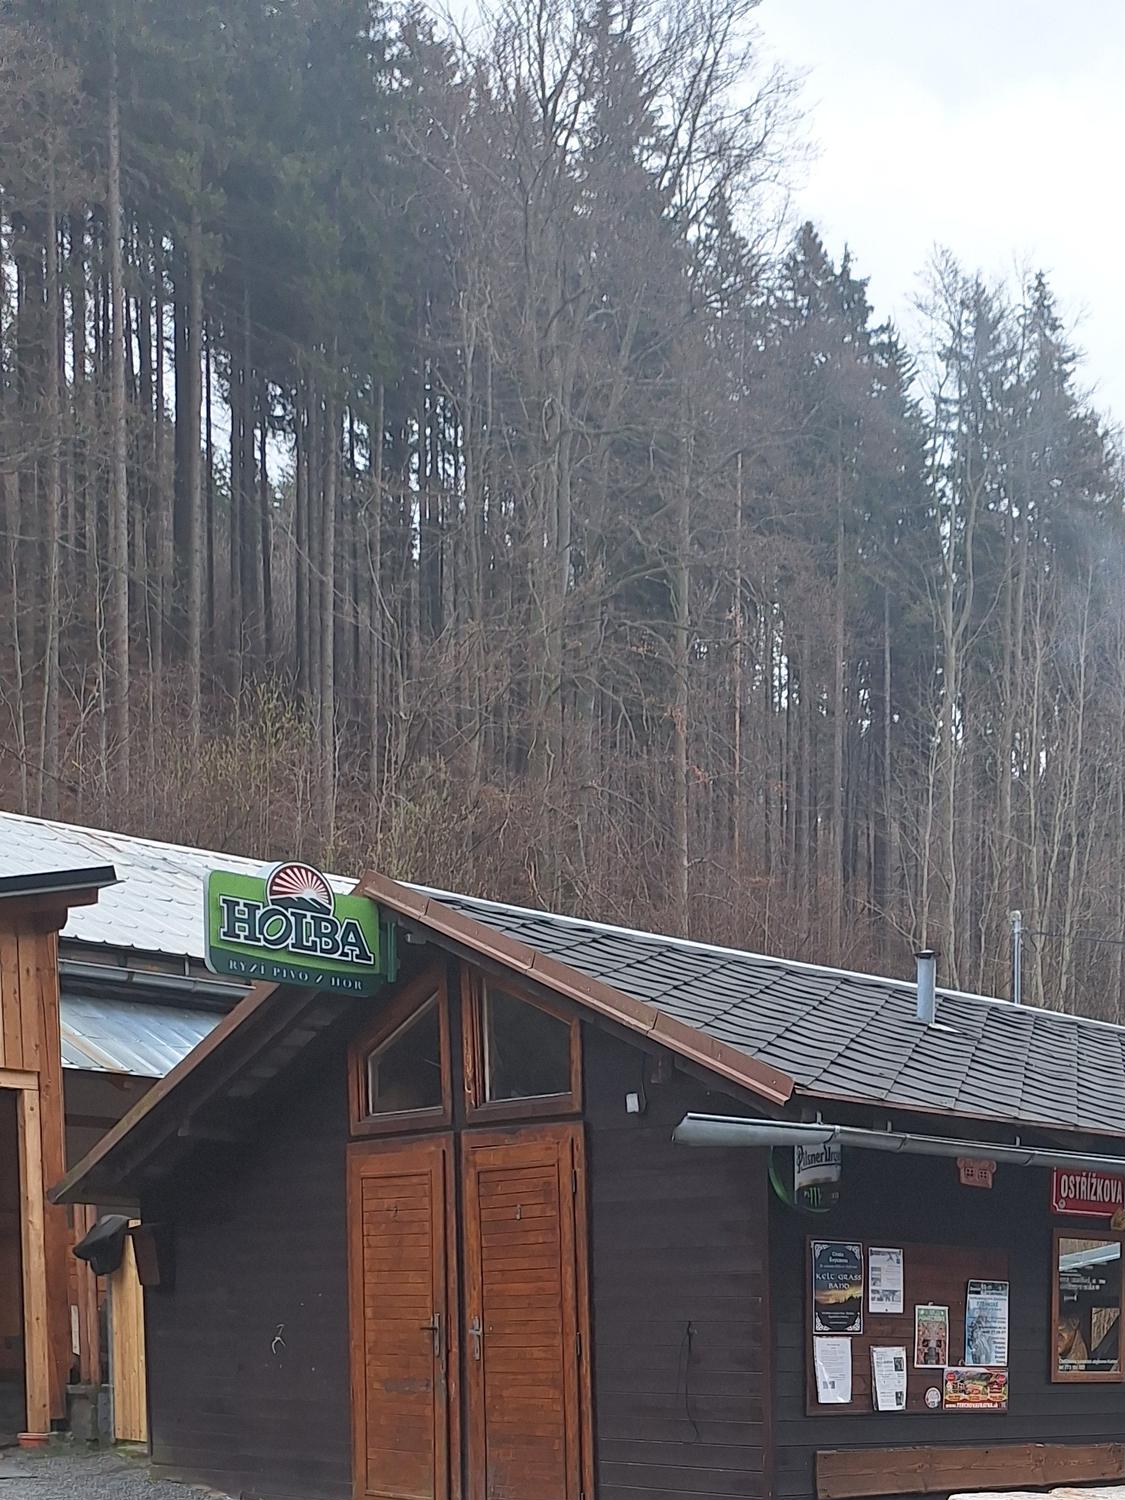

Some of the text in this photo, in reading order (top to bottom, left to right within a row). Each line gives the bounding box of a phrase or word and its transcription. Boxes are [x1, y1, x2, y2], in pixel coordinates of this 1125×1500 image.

[219, 895, 374, 965] HOLBA
[273, 967, 309, 982] PIVO
[331, 976, 363, 991] HOR
[1060, 1171, 1123, 1204] OSTŘÍŽKOVA
